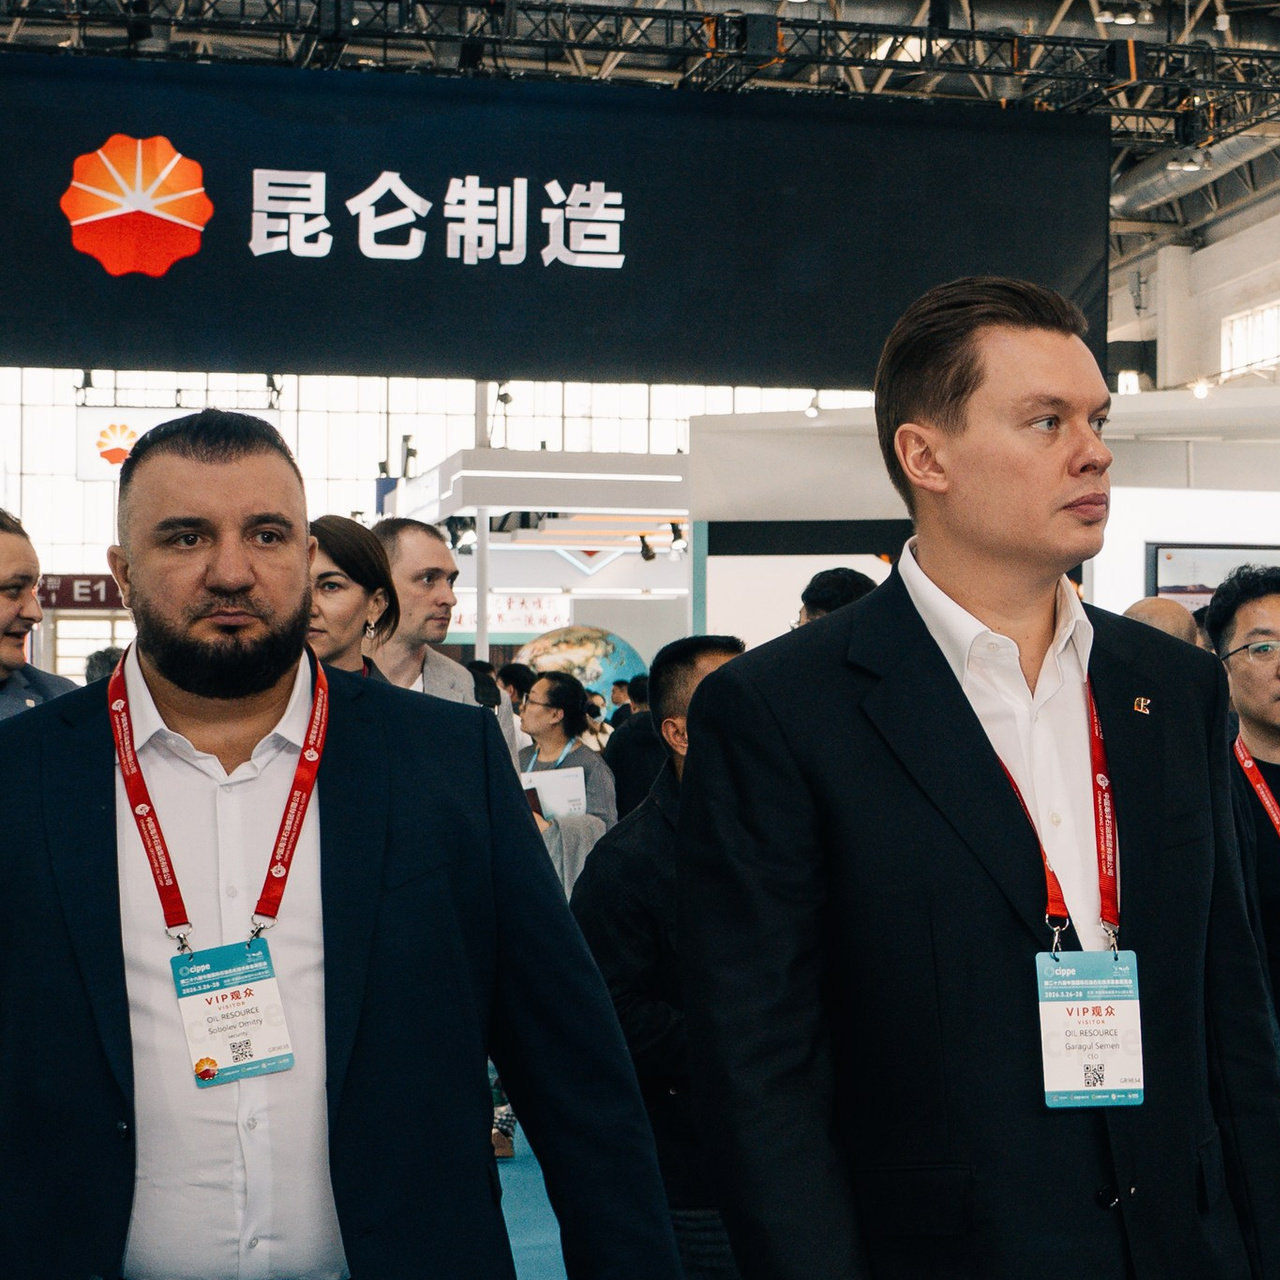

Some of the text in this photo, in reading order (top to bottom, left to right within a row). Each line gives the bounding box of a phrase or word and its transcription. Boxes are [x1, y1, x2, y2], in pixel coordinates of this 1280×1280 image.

[248, 167, 626, 269] 昆仑制造
[73, 579, 107, 602] E1
[217, 1001, 246, 1011] VISITOR
[1065, 1005, 1116, 1017] VIP观众
[220, 1006, 260, 1020] RESOURCE
[1079, 1028, 1119, 1037] RESOURCE
